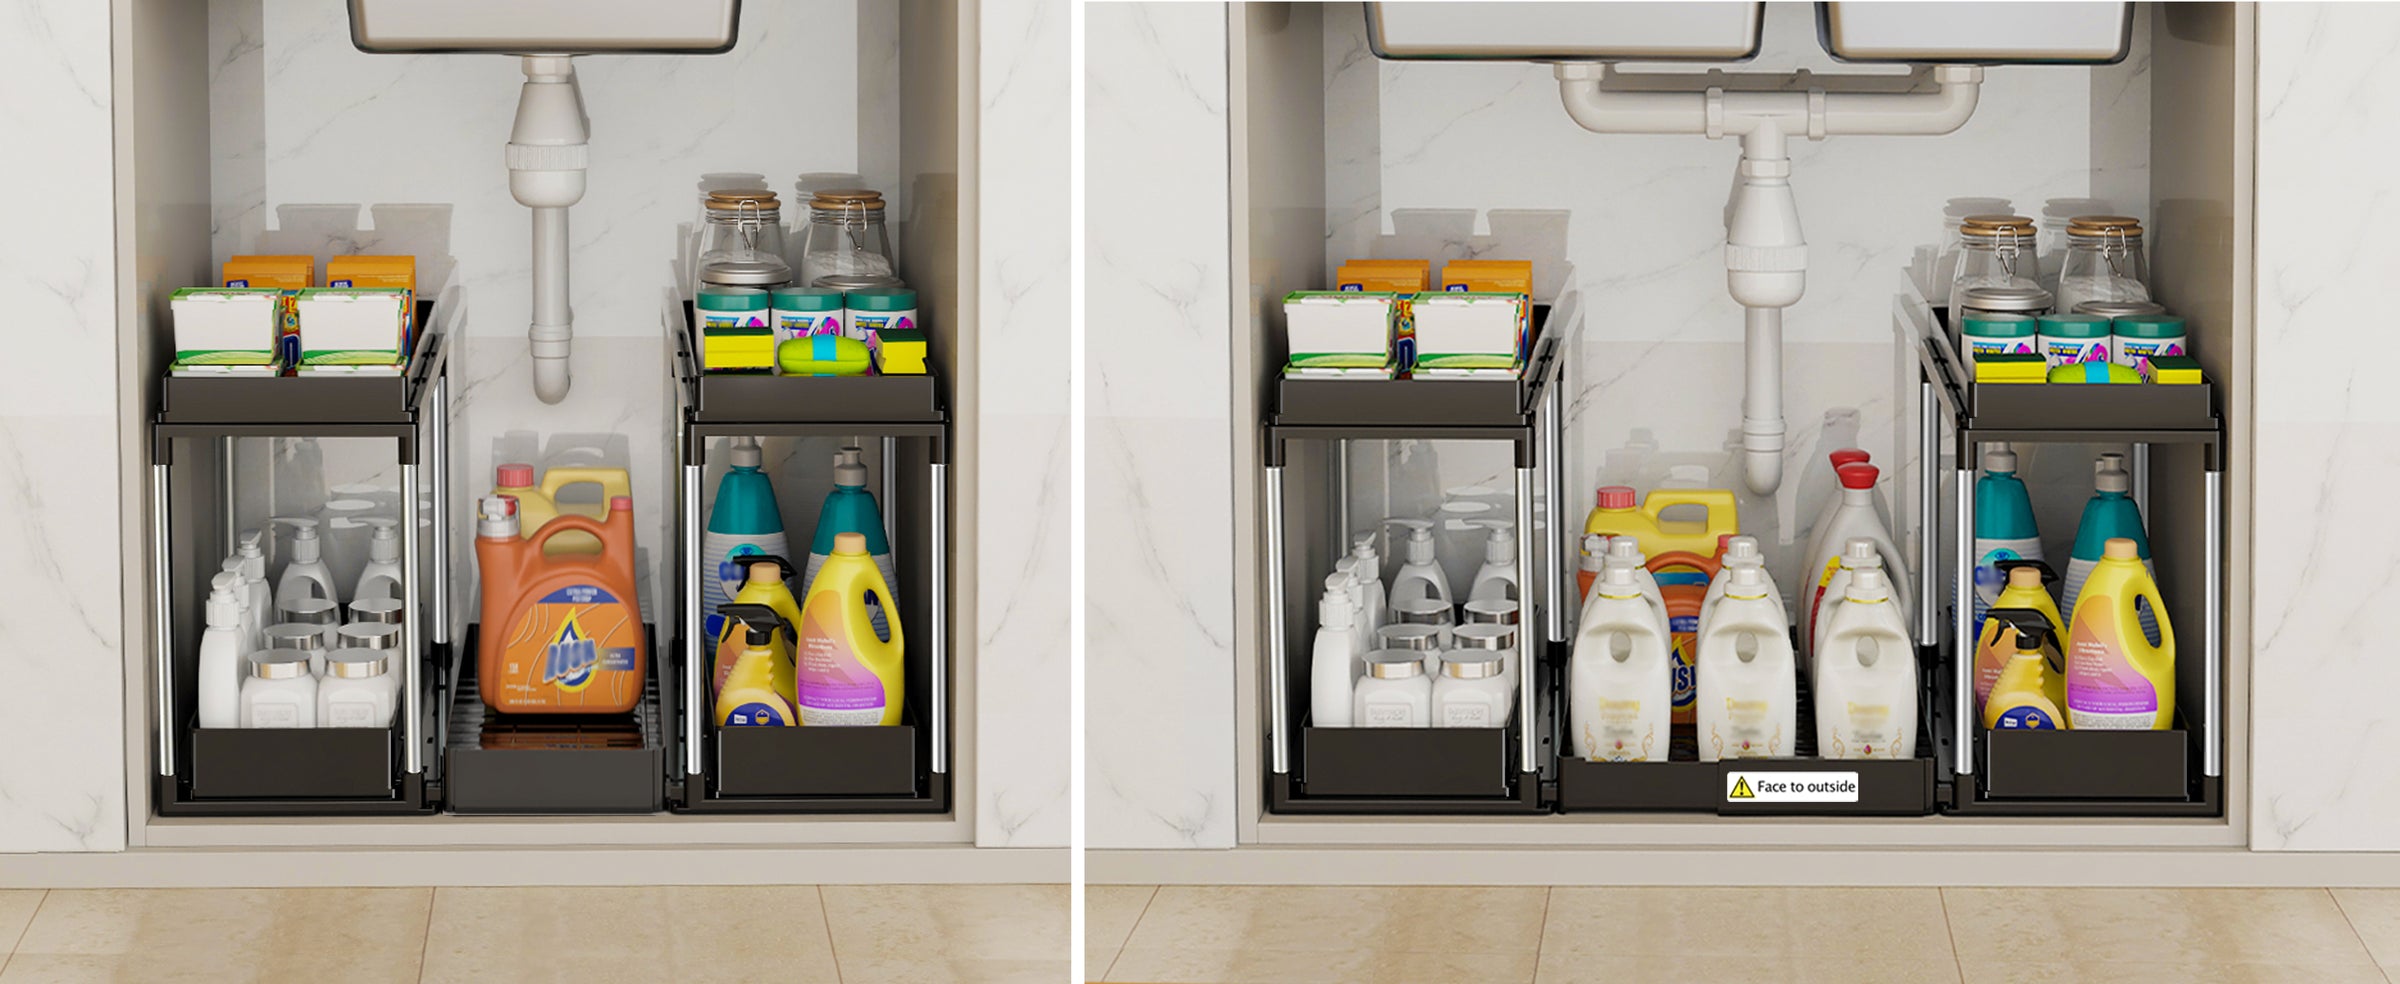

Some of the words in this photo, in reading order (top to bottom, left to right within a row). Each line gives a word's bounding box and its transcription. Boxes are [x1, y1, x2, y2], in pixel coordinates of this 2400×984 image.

[1757, 780, 1787, 793] Face
[1790, 781, 1804, 793] to
[1807, 779, 1856, 793] outside
